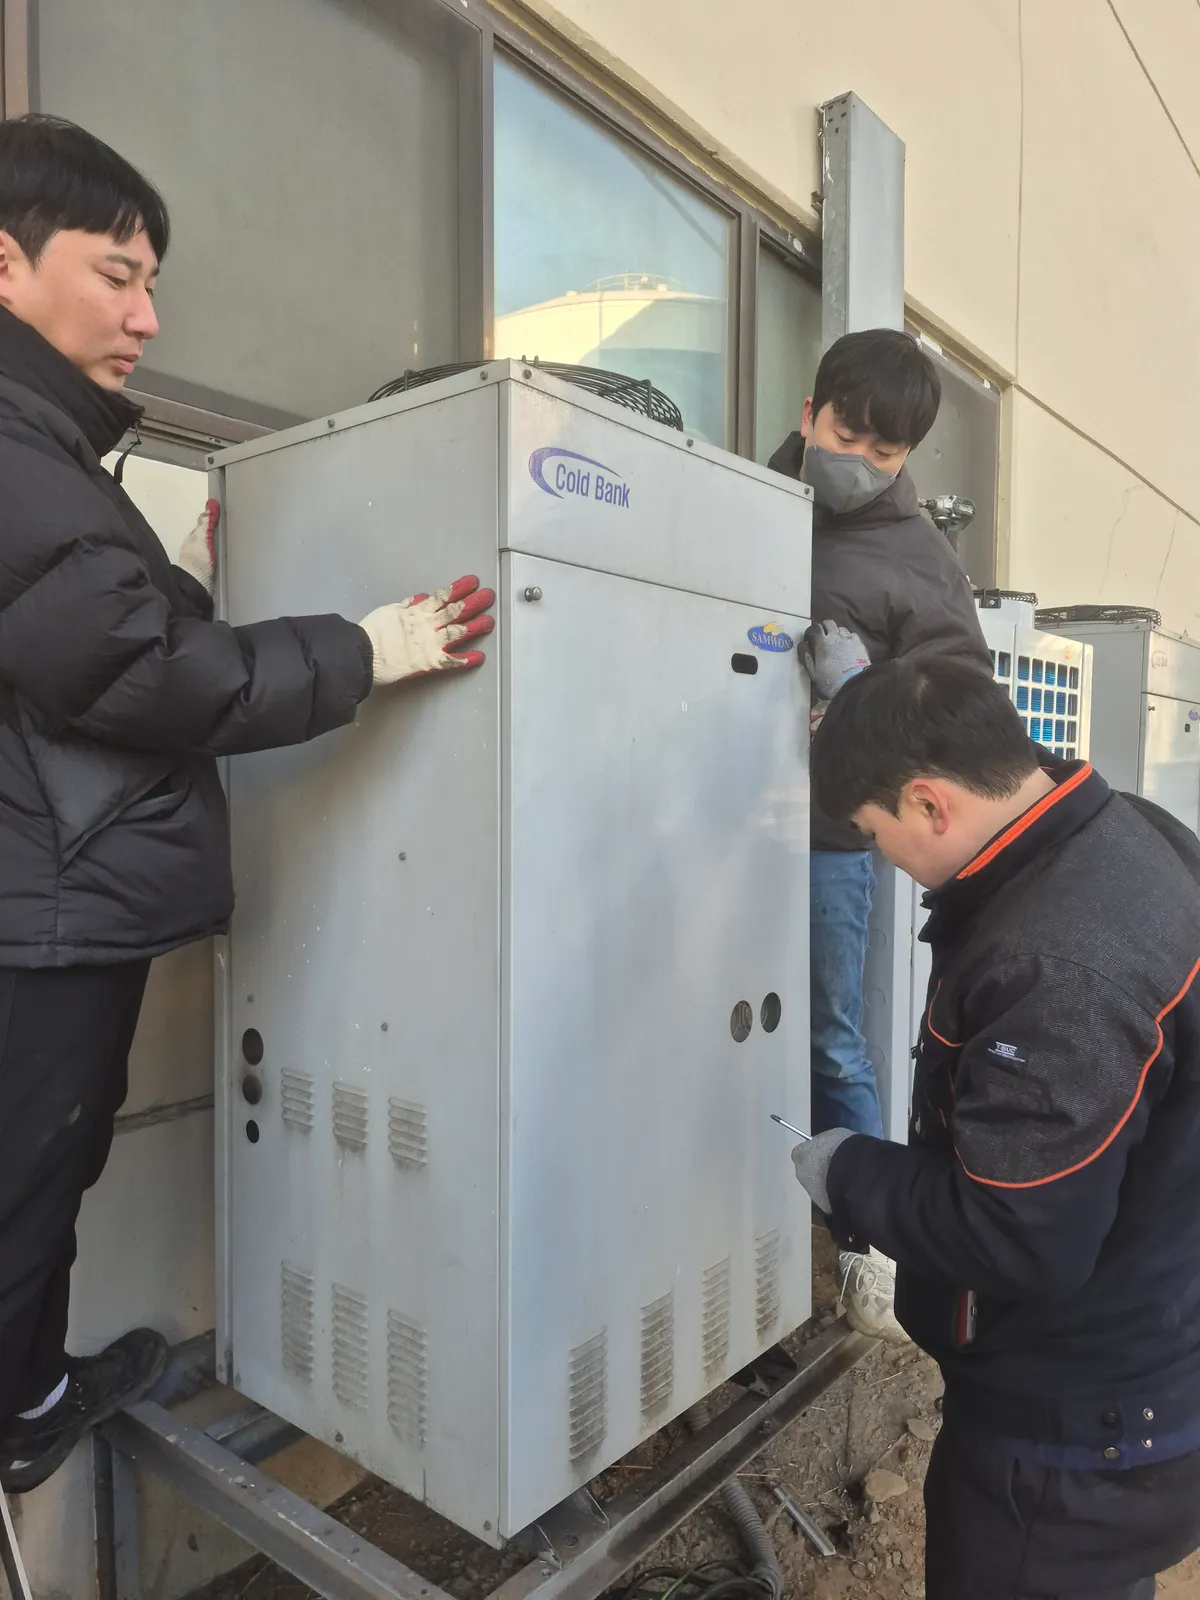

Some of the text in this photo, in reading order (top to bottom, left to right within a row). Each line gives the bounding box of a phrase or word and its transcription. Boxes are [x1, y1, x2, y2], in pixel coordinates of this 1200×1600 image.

[555, 463, 630, 508] Cold Bank
[751, 631, 790, 649] SAMWON
